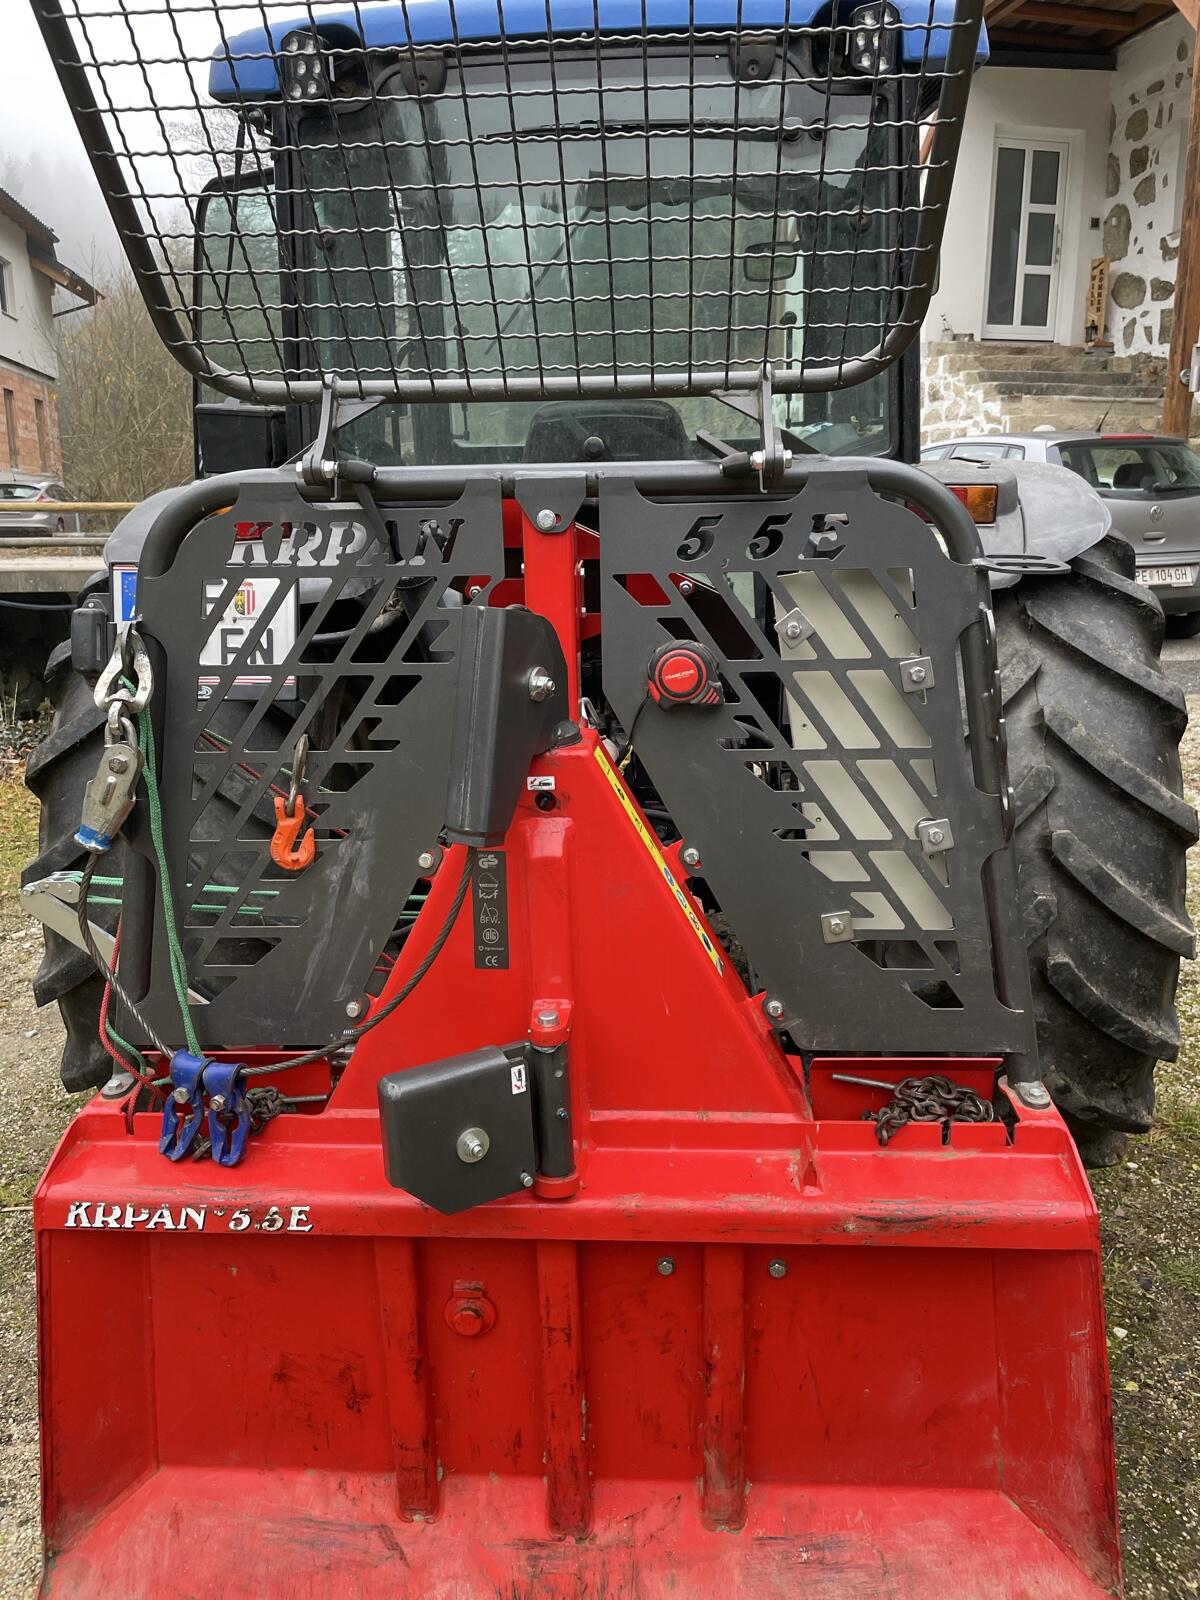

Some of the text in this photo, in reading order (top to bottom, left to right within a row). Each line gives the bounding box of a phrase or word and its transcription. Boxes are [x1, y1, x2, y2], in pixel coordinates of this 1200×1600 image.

[225, 518, 466, 568] KRPAN
[1135, 567, 1188, 583] PE 104 GH
[64, 1201, 208, 1231] KRPAN
